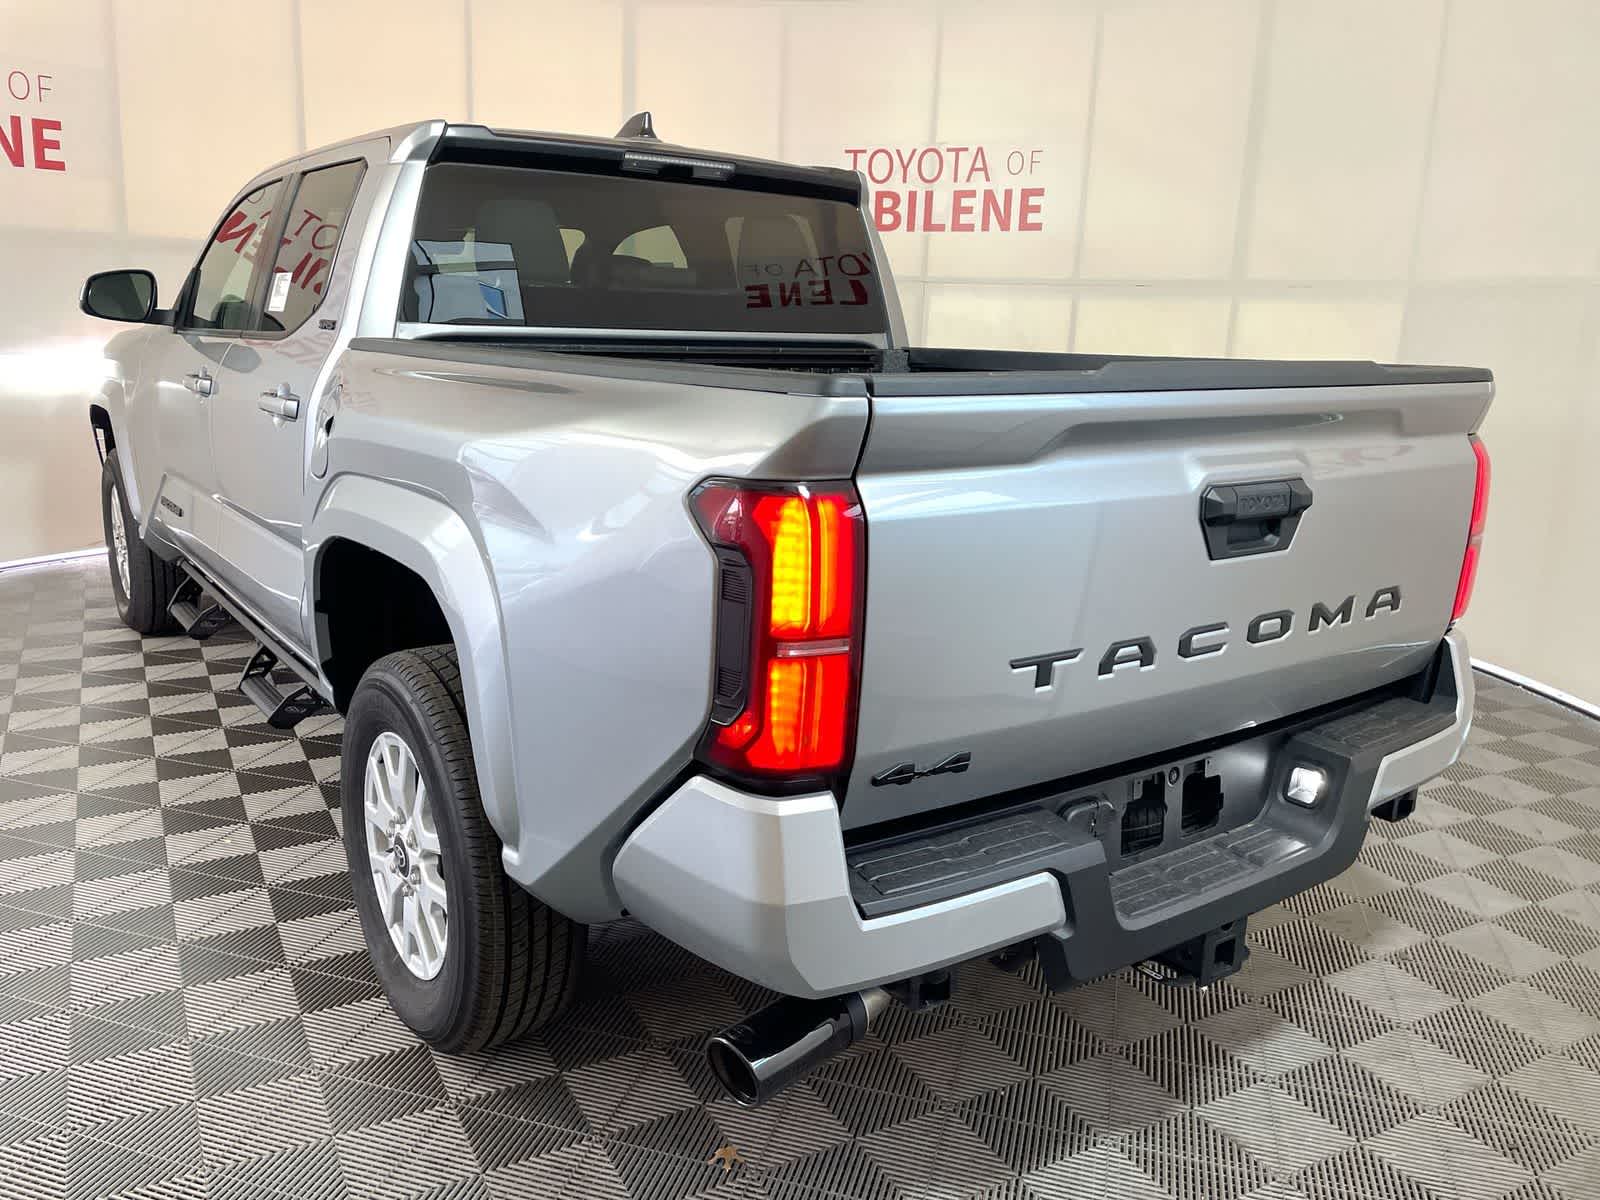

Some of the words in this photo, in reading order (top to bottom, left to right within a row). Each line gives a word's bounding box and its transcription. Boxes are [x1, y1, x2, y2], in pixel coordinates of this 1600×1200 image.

[8, 70, 52, 102] OF
[844, 146, 991, 185] TOYOTA
[1007, 150, 1043, 175] OF
[873, 188, 1045, 232] BILENE
[1240, 494, 1288, 511] TOYOTA
[1008, 585, 1402, 692] TACOMA
